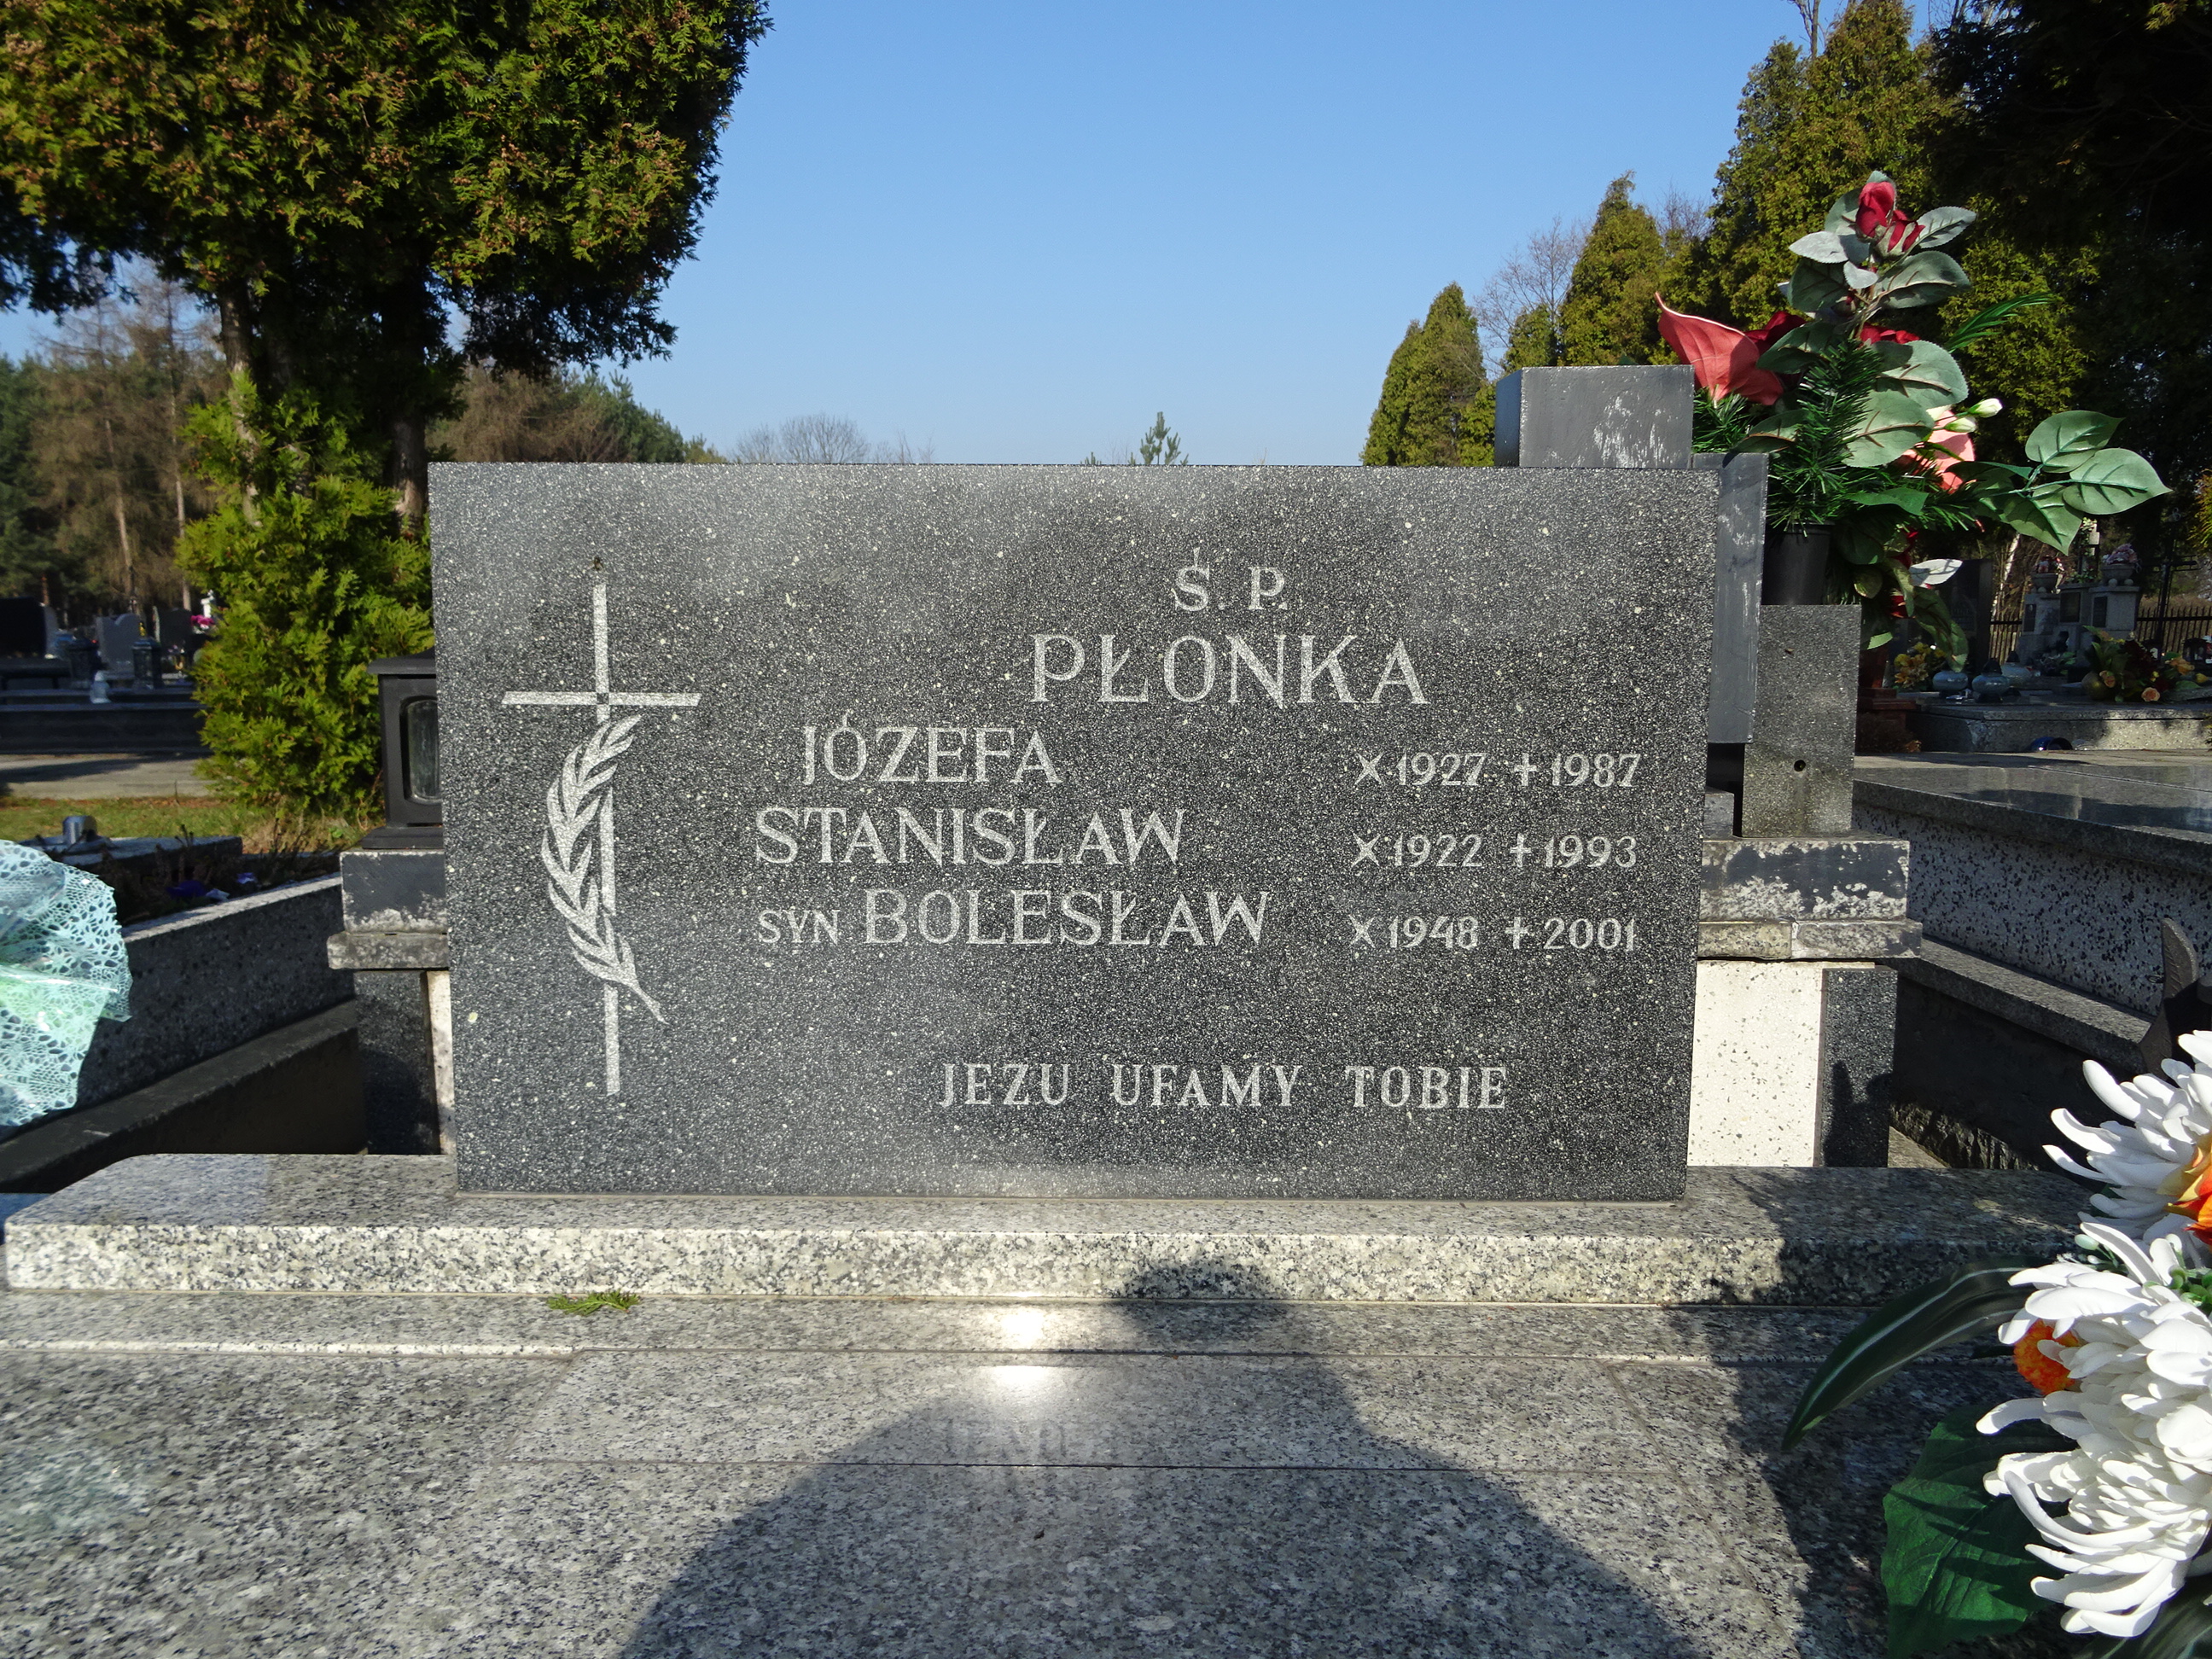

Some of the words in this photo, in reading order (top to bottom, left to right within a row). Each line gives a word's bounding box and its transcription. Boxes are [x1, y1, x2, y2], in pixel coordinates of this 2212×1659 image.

[1029, 634, 1429, 707] PŁONKA
[800, 710, 1063, 786] JÓZEFA
[754, 806, 1187, 865] STANISŁAW
[757, 908, 841, 946] SYN
[863, 888, 1270, 947] BOLESŁAW
[942, 1062, 1071, 1109] JEZU
[1110, 1063, 1302, 1109] UFAMY
[1344, 1065, 1508, 1111] TOBIE
